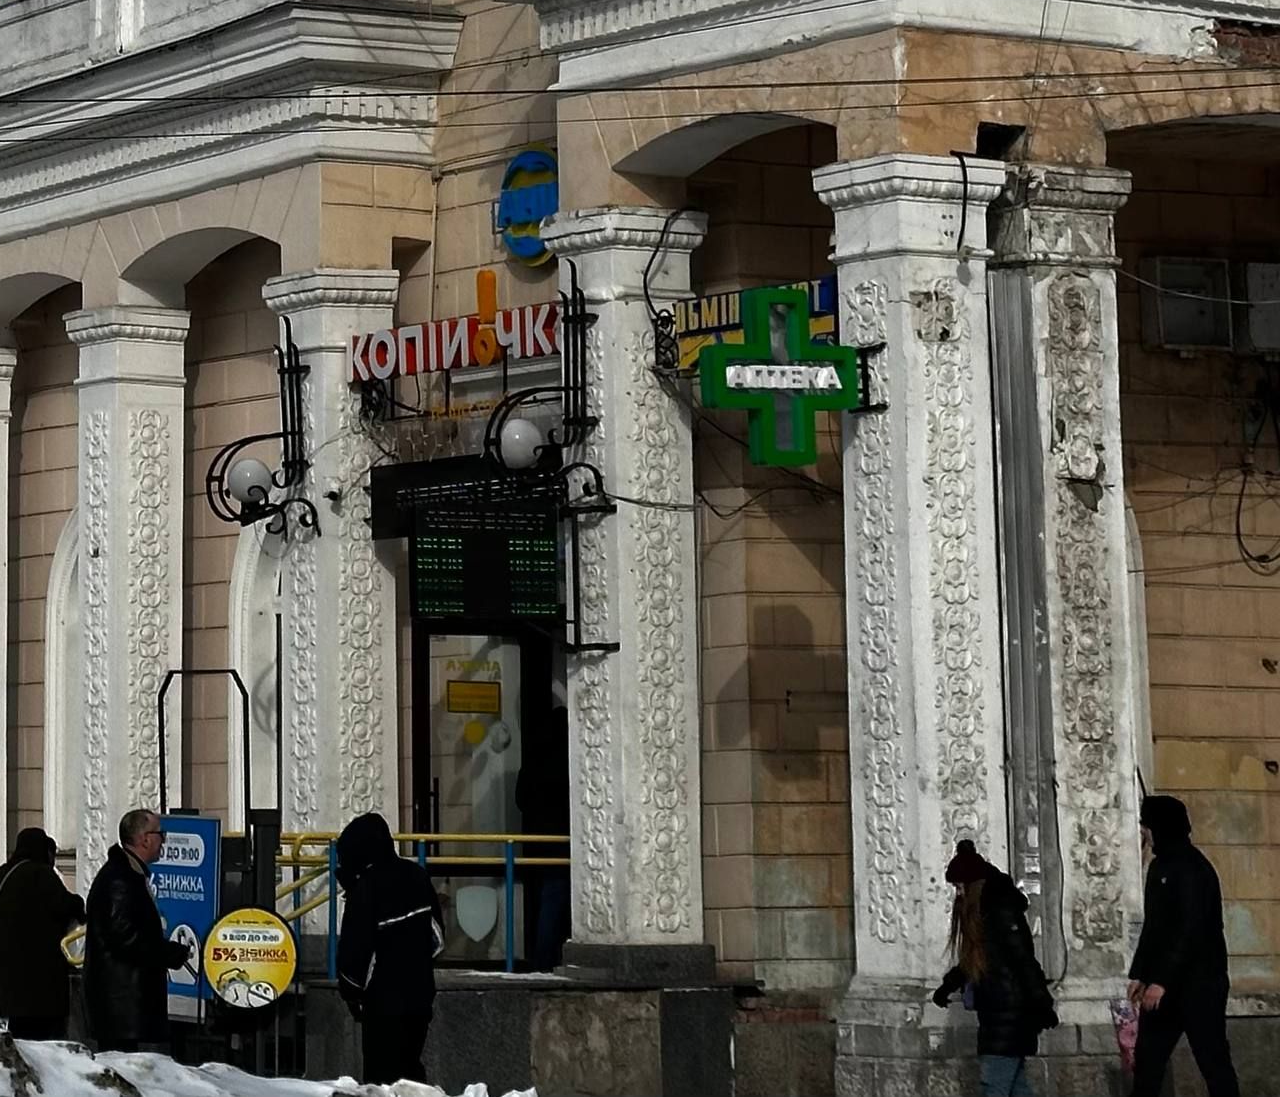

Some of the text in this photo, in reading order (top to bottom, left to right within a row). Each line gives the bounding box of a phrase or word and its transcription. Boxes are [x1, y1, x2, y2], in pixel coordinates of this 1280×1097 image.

[675, 293, 740, 334] ОБМІН
[725, 365, 843, 389] АПТЕКА
[158, 873, 205, 892] ЗНИЖКА
[212, 947, 288, 962] 5% ЗНИЖКА
